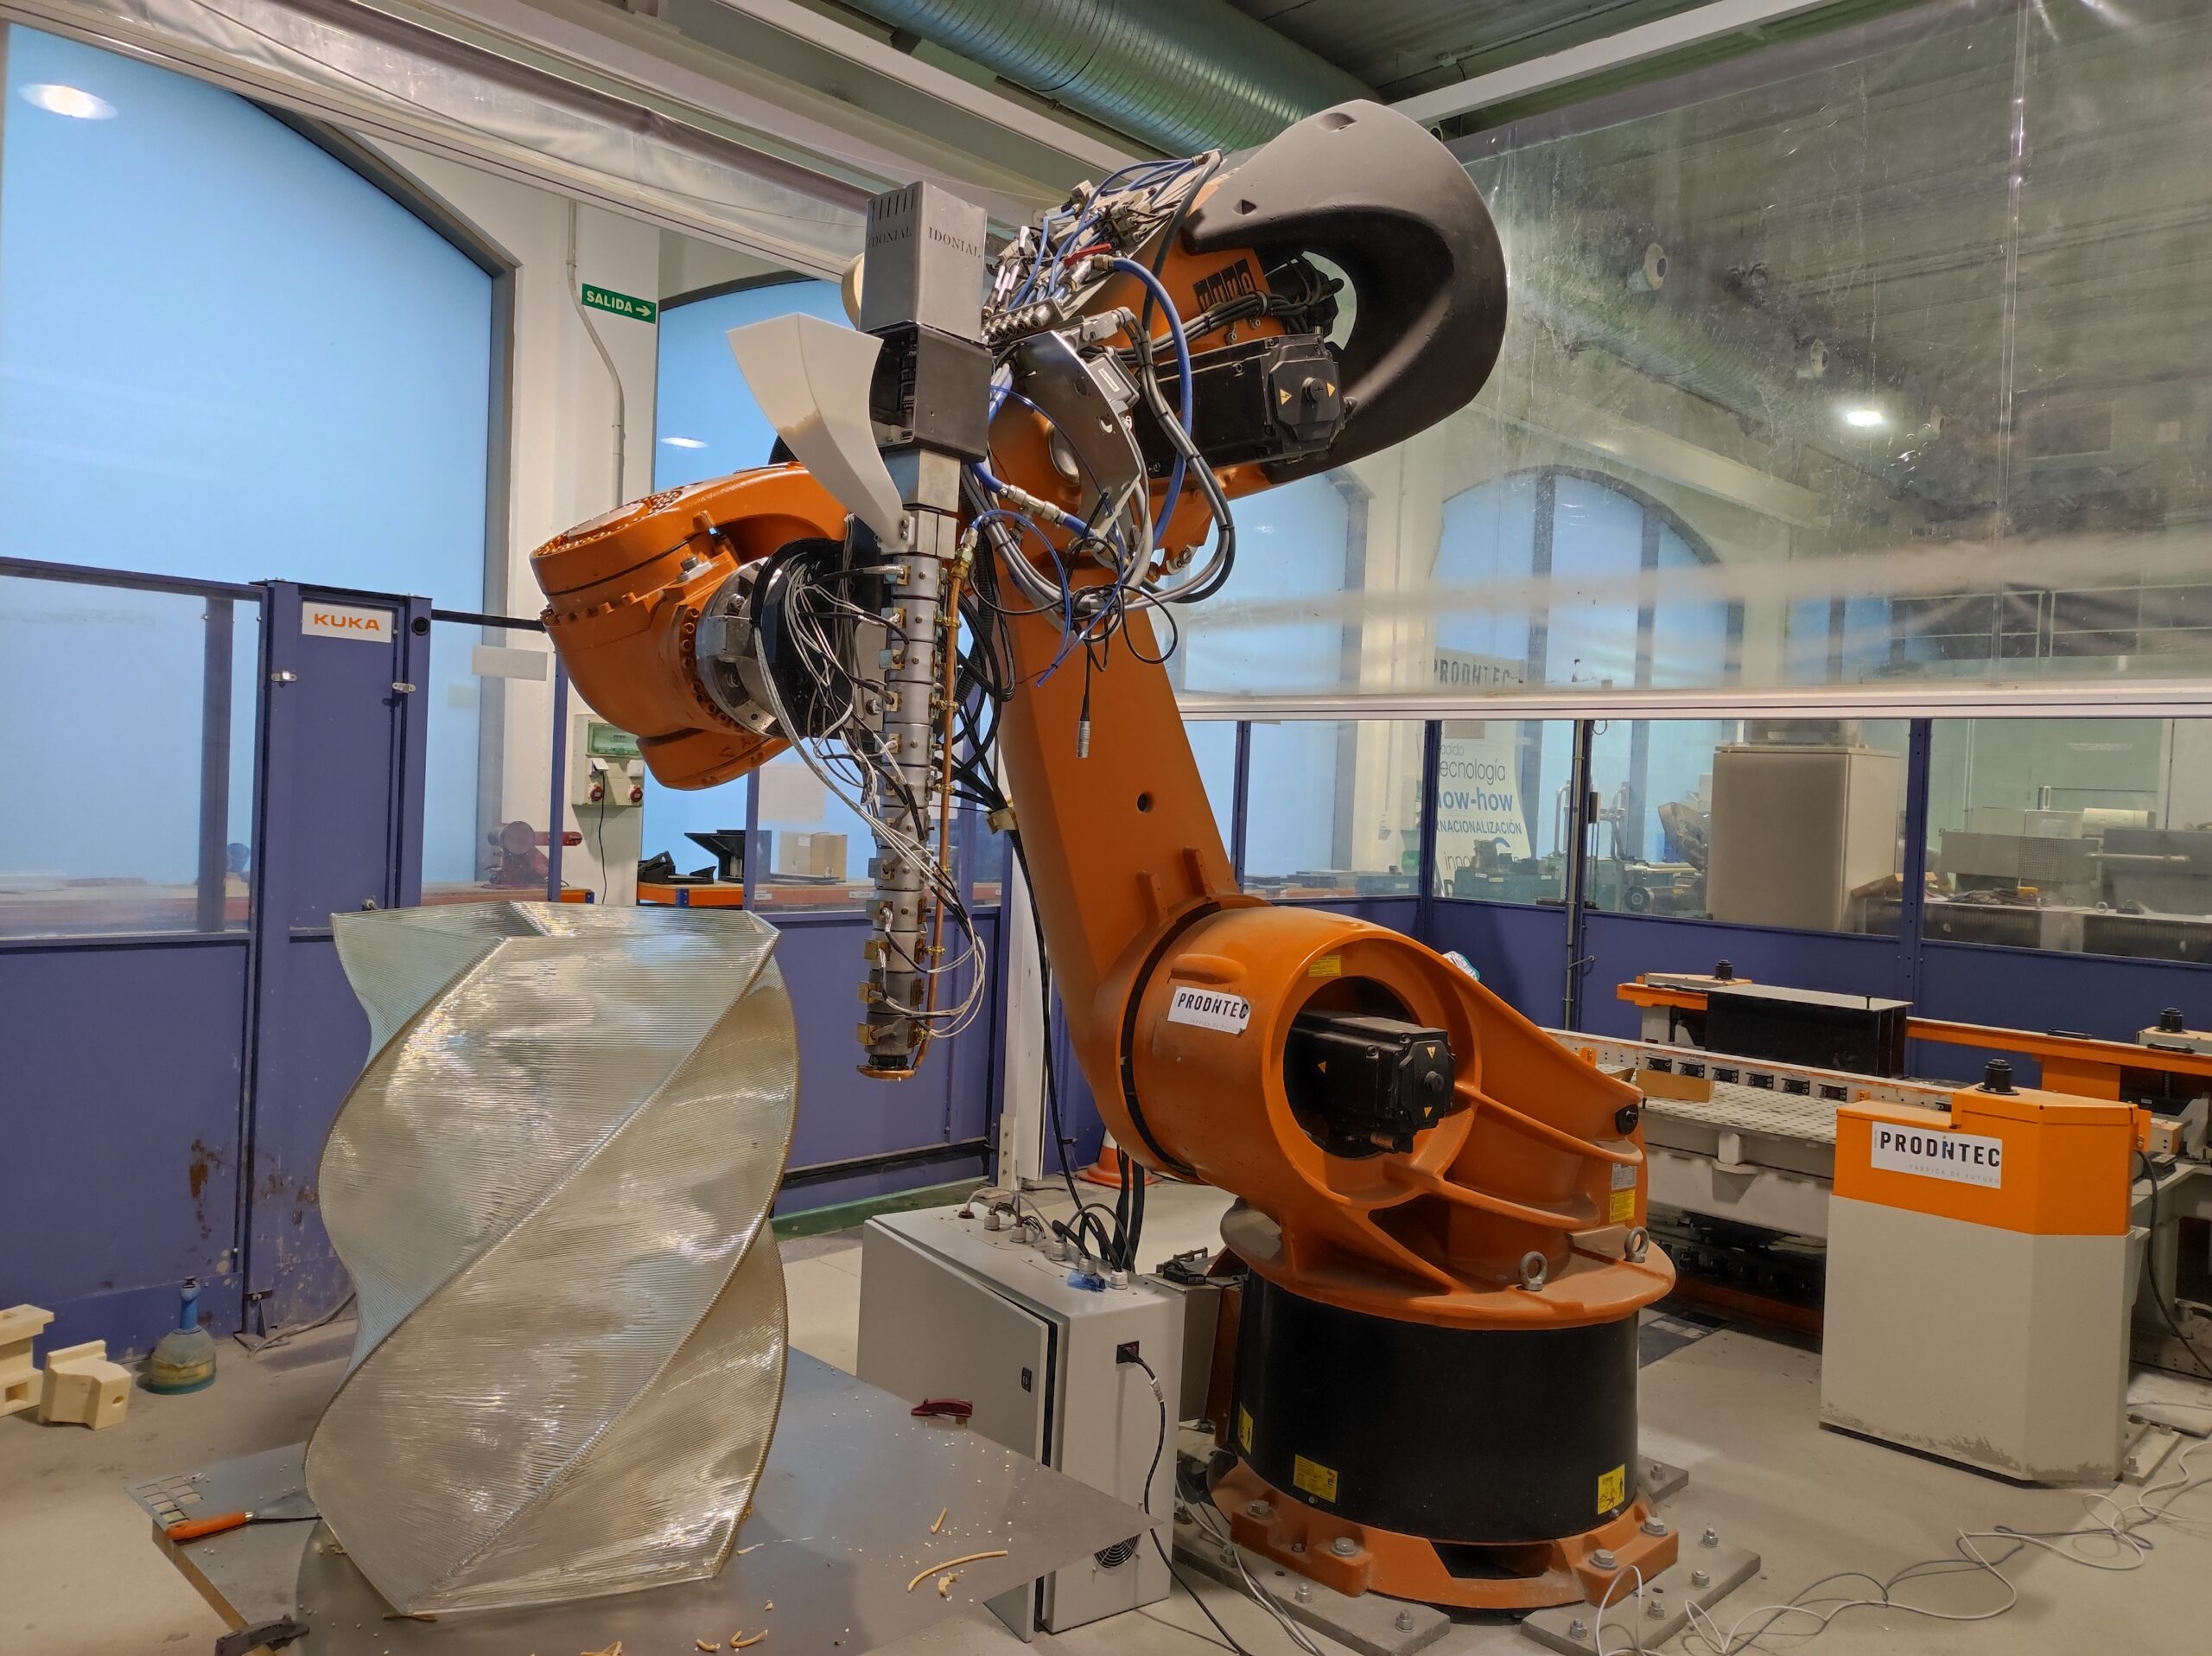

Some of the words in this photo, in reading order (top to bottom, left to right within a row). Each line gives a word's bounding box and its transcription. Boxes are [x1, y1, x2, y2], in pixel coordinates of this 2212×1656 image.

[928, 227, 982, 258] IDONIAL
[586, 290, 633, 314] SALIDA
[314, 613, 380, 631] KUKA
[1440, 757, 1506, 786] ecnología
